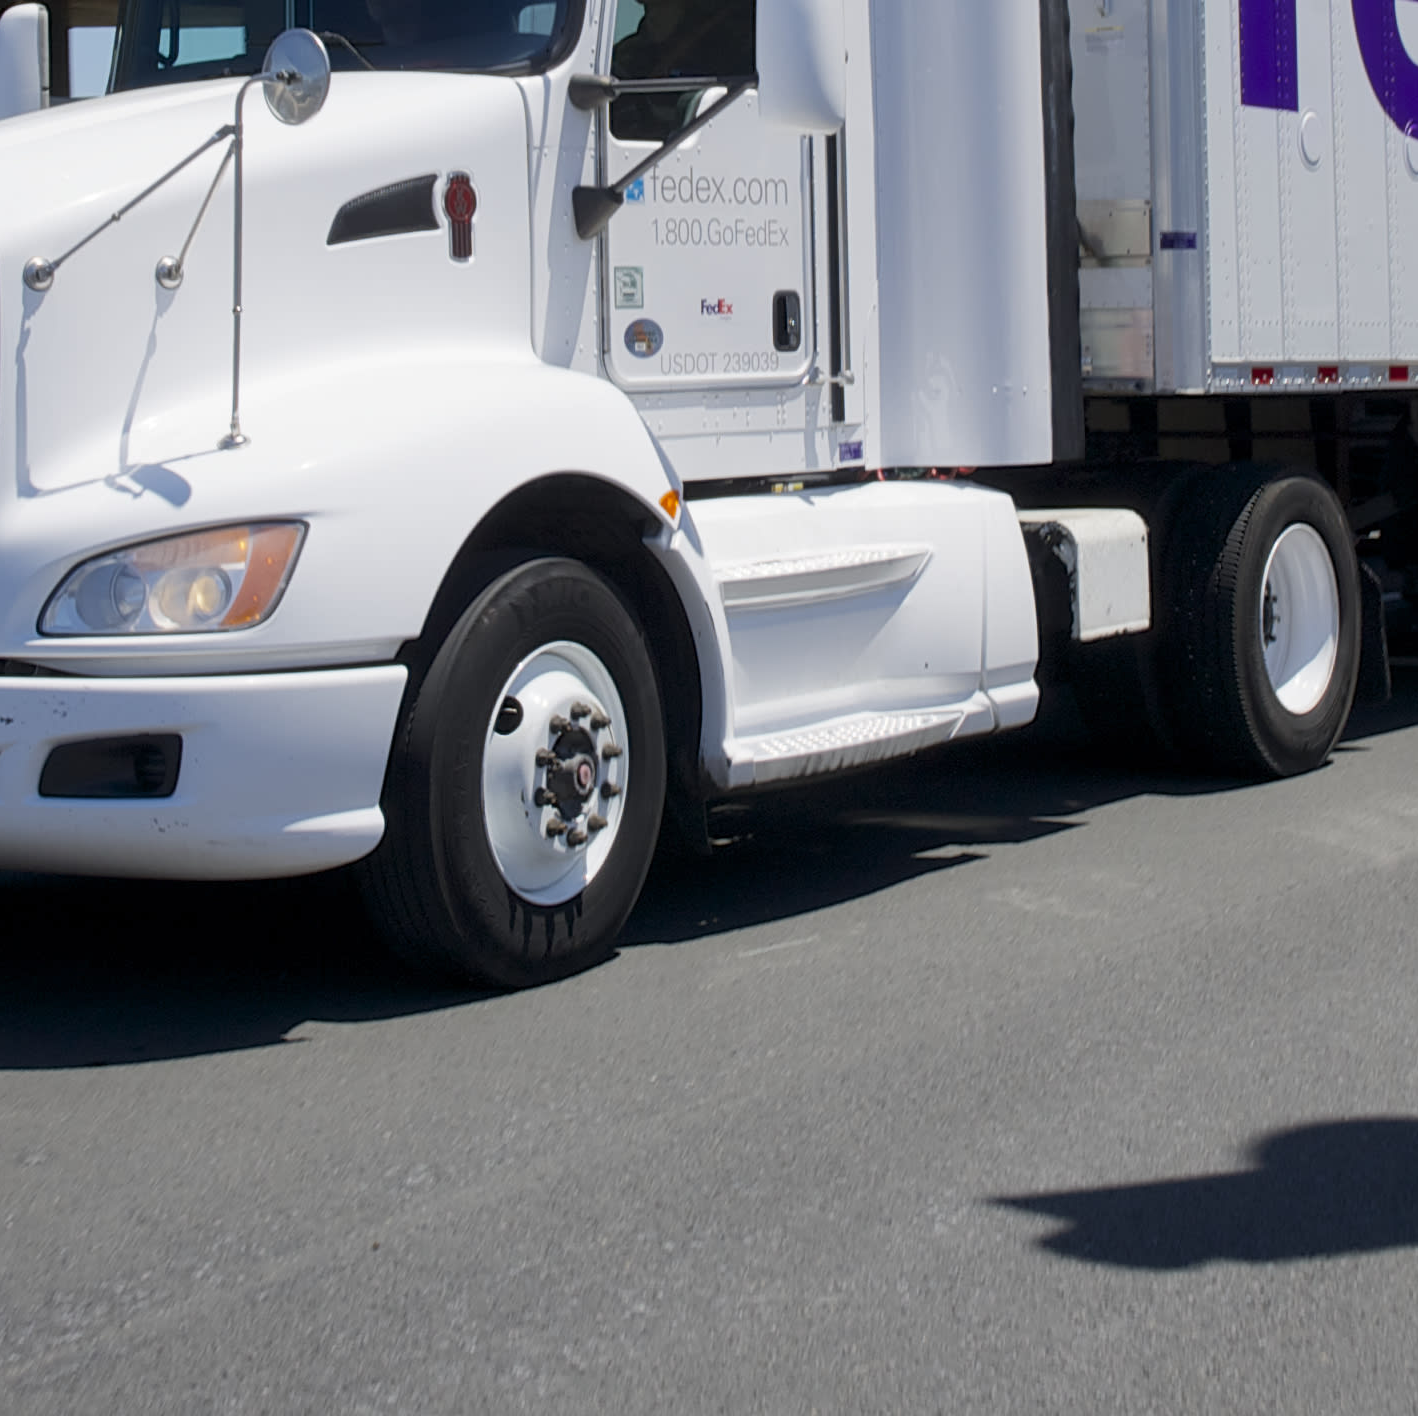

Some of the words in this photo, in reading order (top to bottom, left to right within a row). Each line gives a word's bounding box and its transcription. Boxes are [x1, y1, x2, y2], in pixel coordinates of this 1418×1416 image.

[650, 164, 789, 206] fedex.com
[651, 217, 790, 247] 1.800.GoFedEx
[700, 298, 733, 315] FedEx
[660, 353, 716, 375] USDOT
[723, 351, 780, 374] 239039
